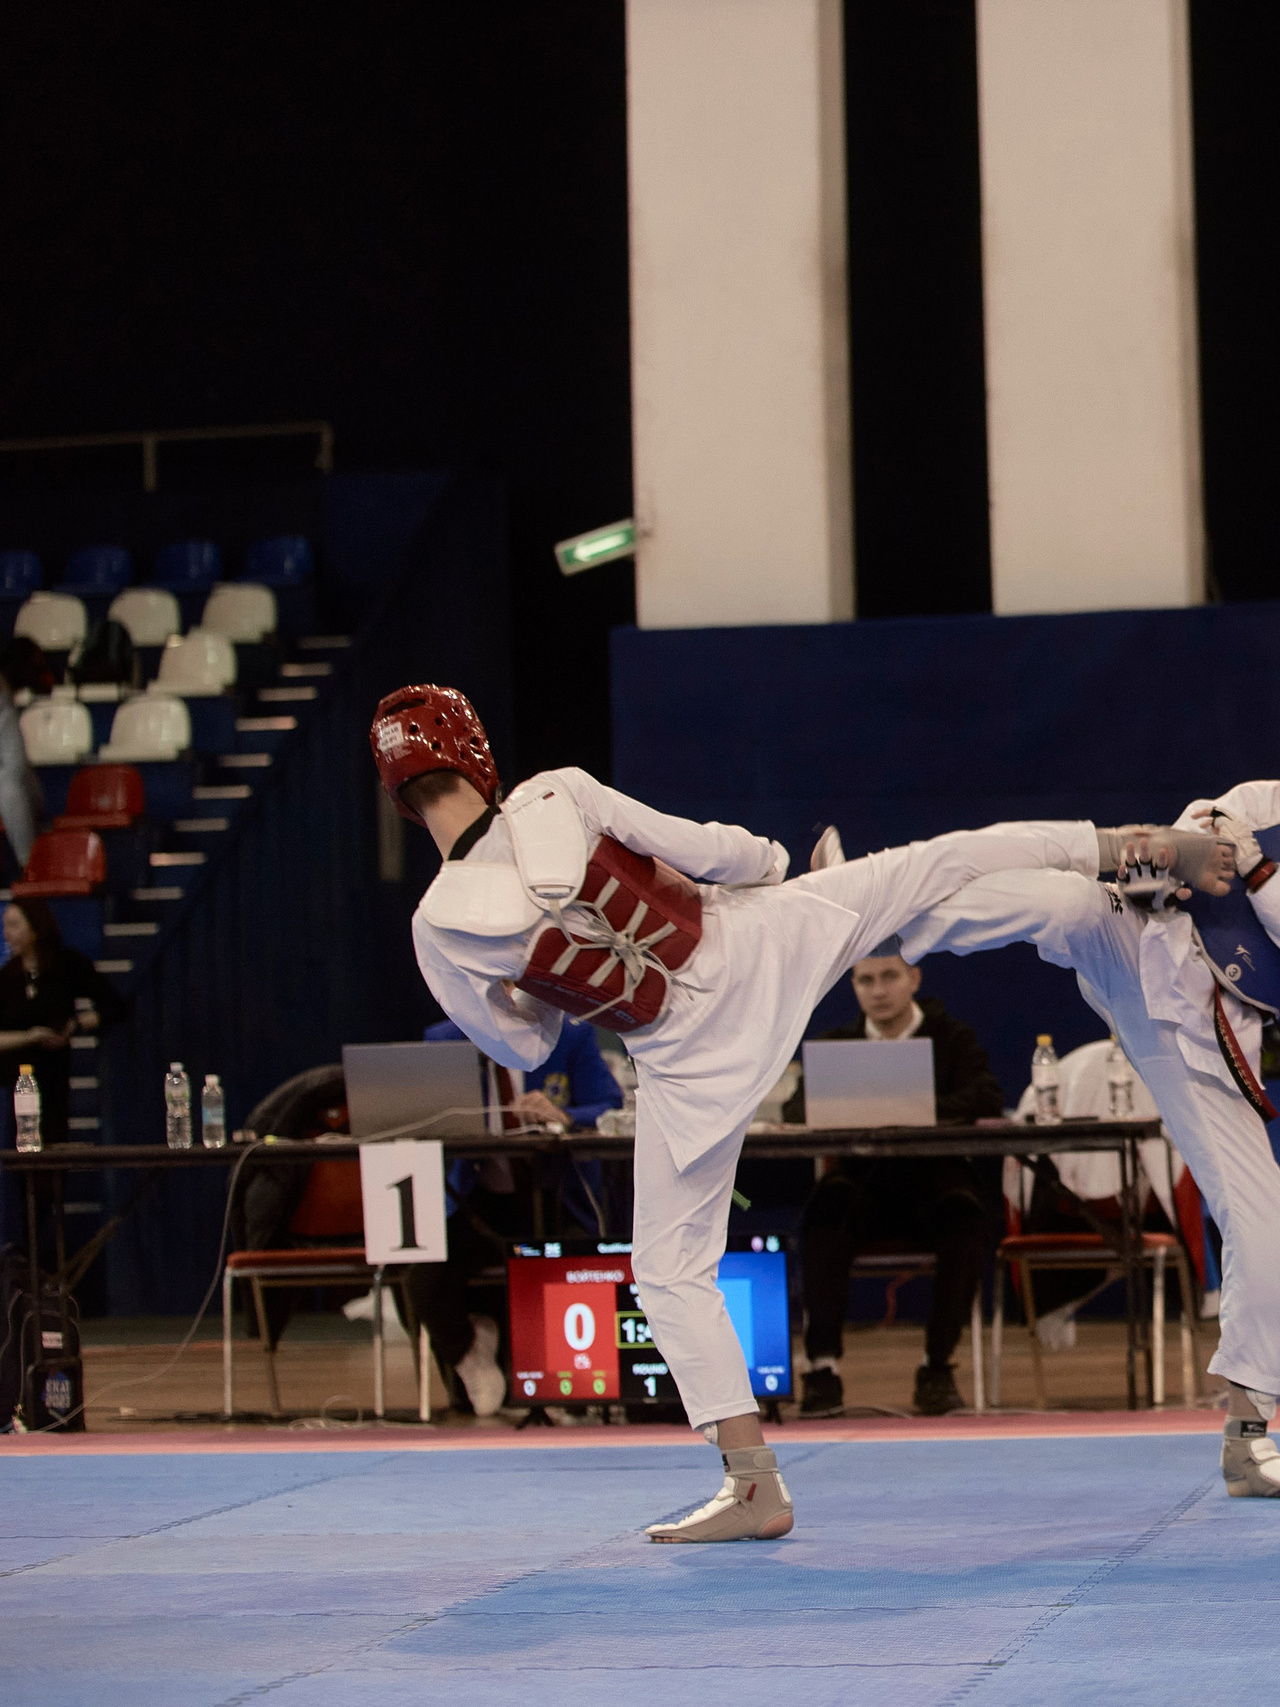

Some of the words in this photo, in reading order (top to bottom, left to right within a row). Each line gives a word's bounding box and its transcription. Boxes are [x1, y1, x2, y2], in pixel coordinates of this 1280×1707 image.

[1228, 967, 1239, 979] 3
[386, 1173, 428, 1252] 1
[563, 1302, 596, 1351] 0
[632, 1363, 668, 1375] ROUND
[523, 1379, 537, 1396] 0
[559, 1378, 573, 1395] 0
[593, 1378, 606, 1395] 0
[643, 1376, 657, 1397] 1
[765, 1374, 778, 1391] 0
